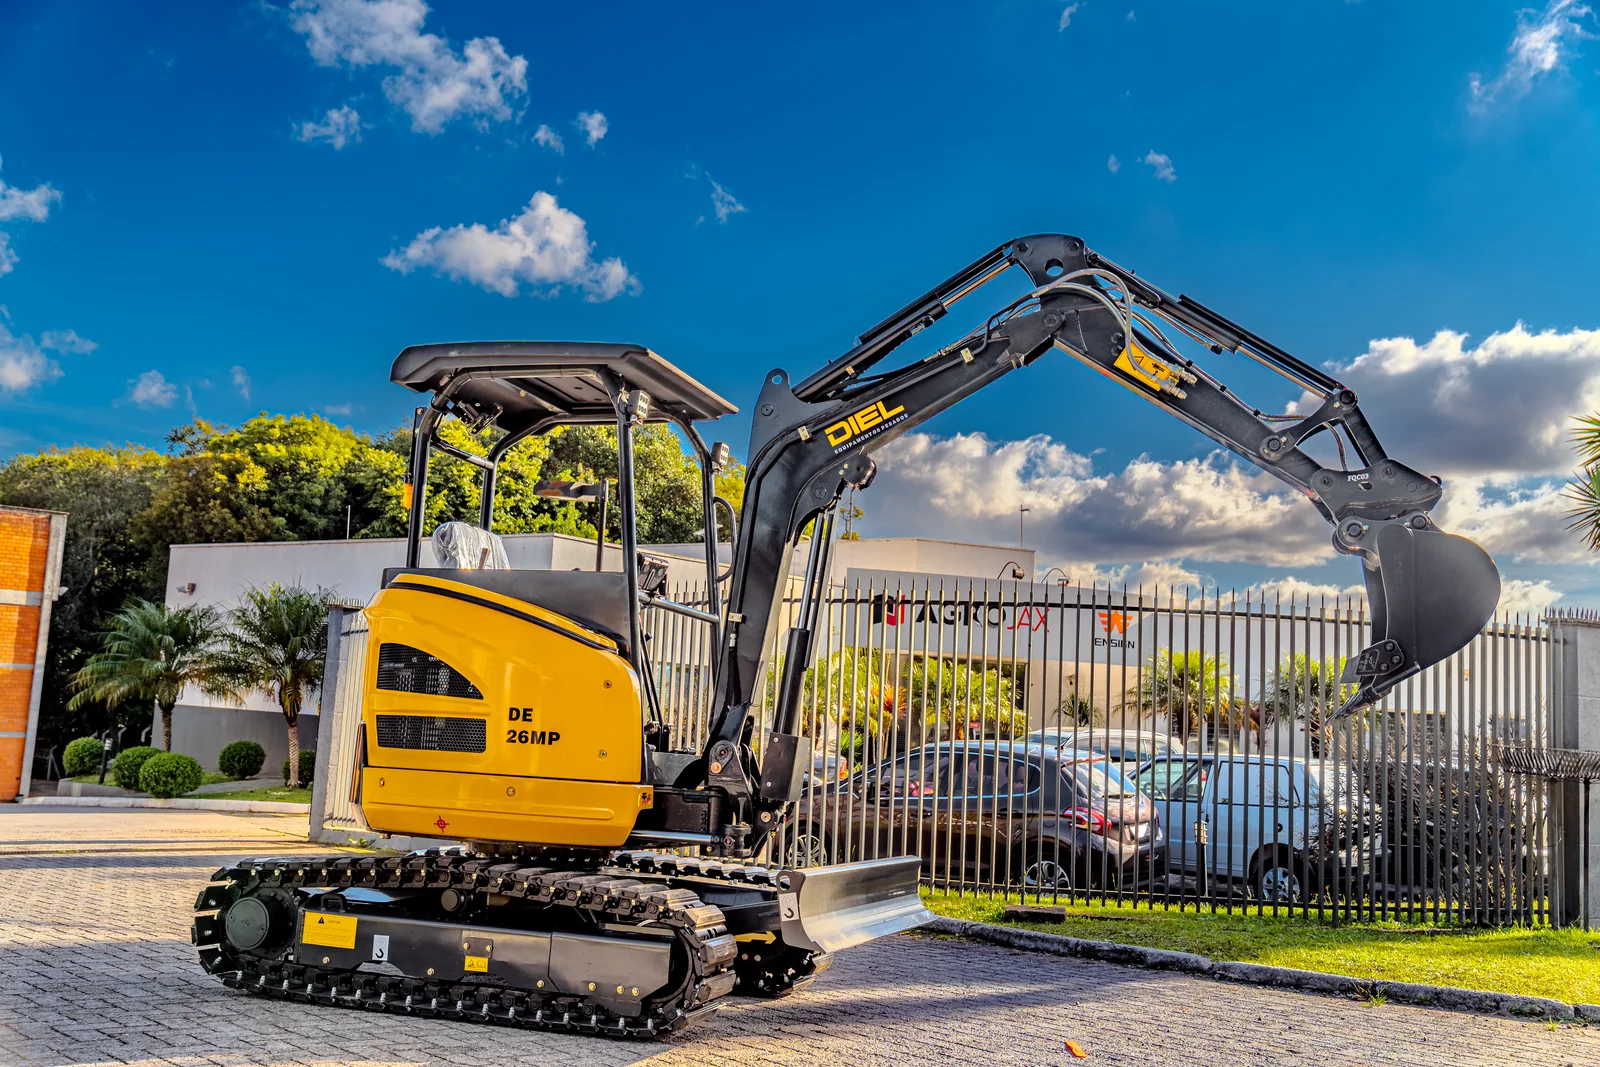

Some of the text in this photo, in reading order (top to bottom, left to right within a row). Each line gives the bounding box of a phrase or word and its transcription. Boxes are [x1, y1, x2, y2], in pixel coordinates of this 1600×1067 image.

[824, 400, 906, 448] DIEL
[834, 413, 909, 455] EQUIPAMENTOS PESADOS
[1094, 637, 1135, 649] ENSIN
[508, 707, 534, 722] DE
[505, 729, 561, 746] 26MP
